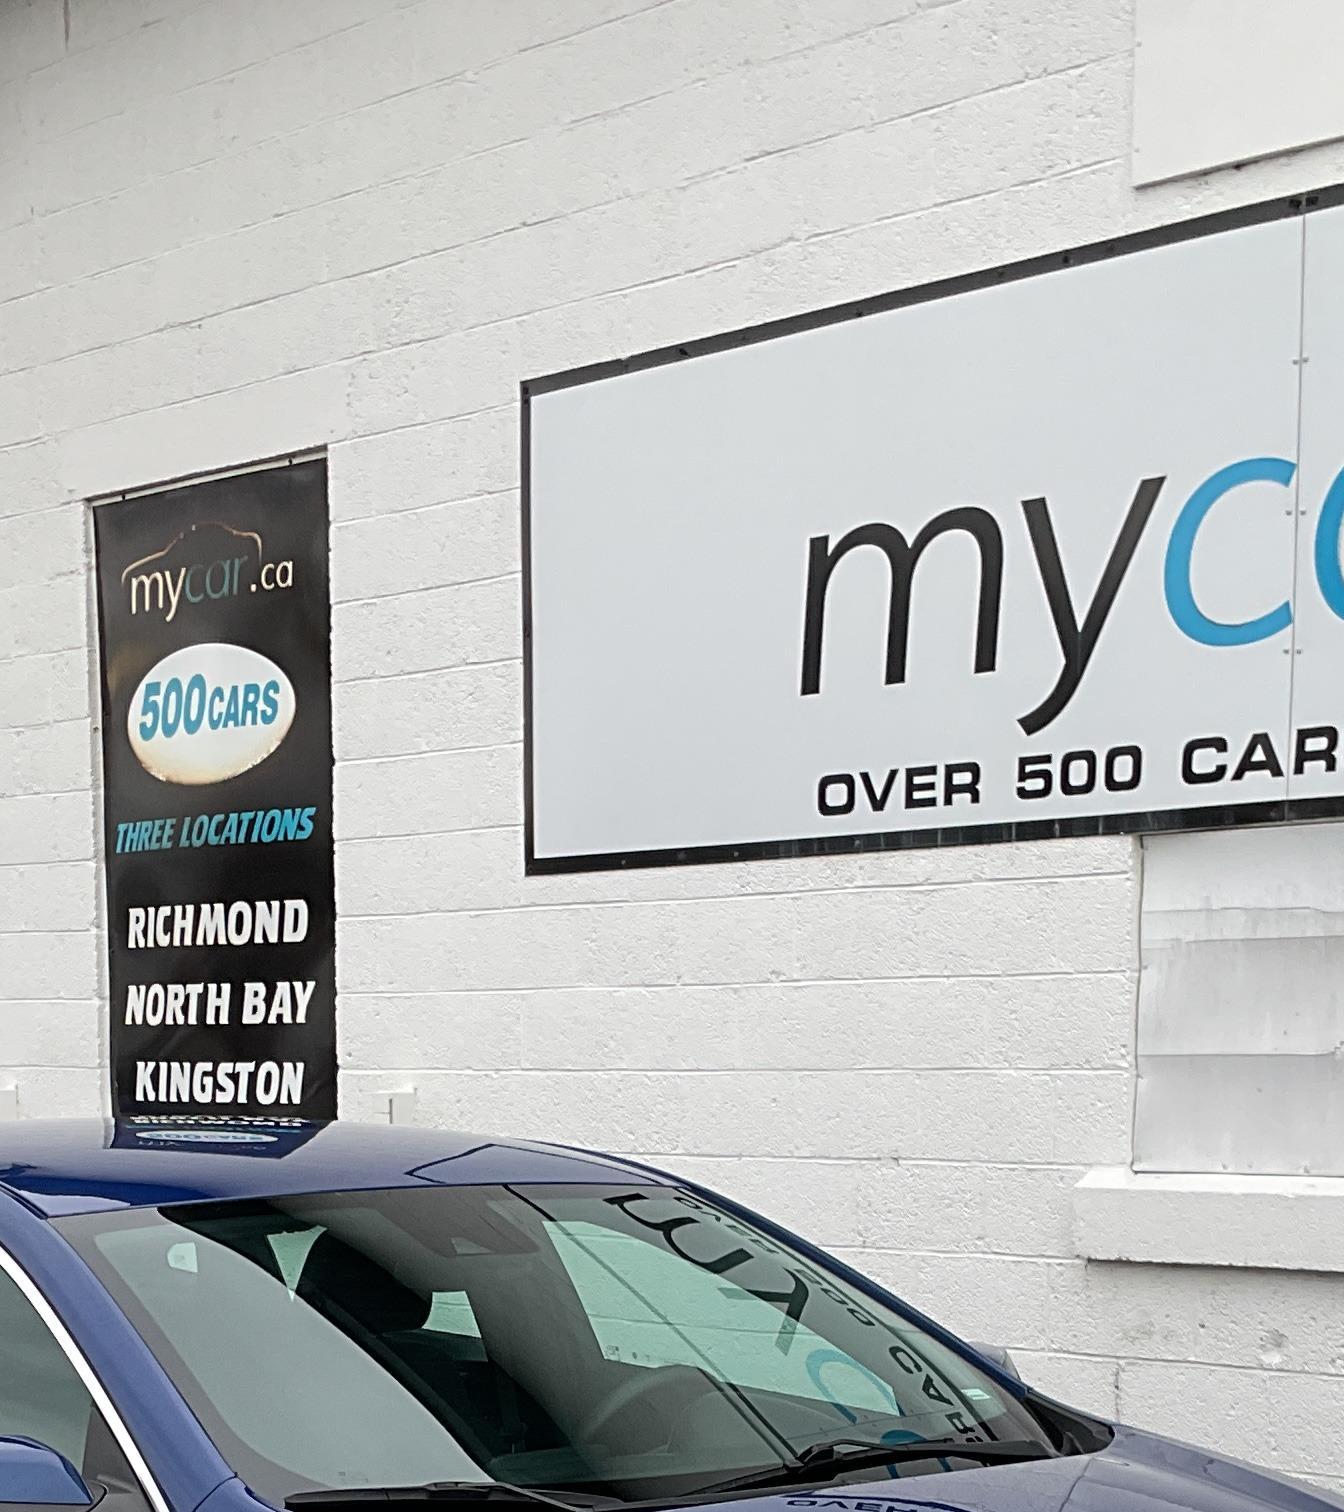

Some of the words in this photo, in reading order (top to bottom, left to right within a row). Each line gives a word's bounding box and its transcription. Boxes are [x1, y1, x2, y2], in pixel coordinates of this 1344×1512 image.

[131, 556, 294, 622] mycar.ca
[816, 766, 981, 817] OVER
[1016, 746, 1143, 800] 500
[116, 819, 174, 854] THREE
[179, 807, 316, 848] LOCATIONS
[127, 899, 309, 949] RICHMOND
[124, 982, 230, 1027] NORTH
[242, 980, 316, 1025] BAY
[135, 1060, 305, 1105] KINGSTON
